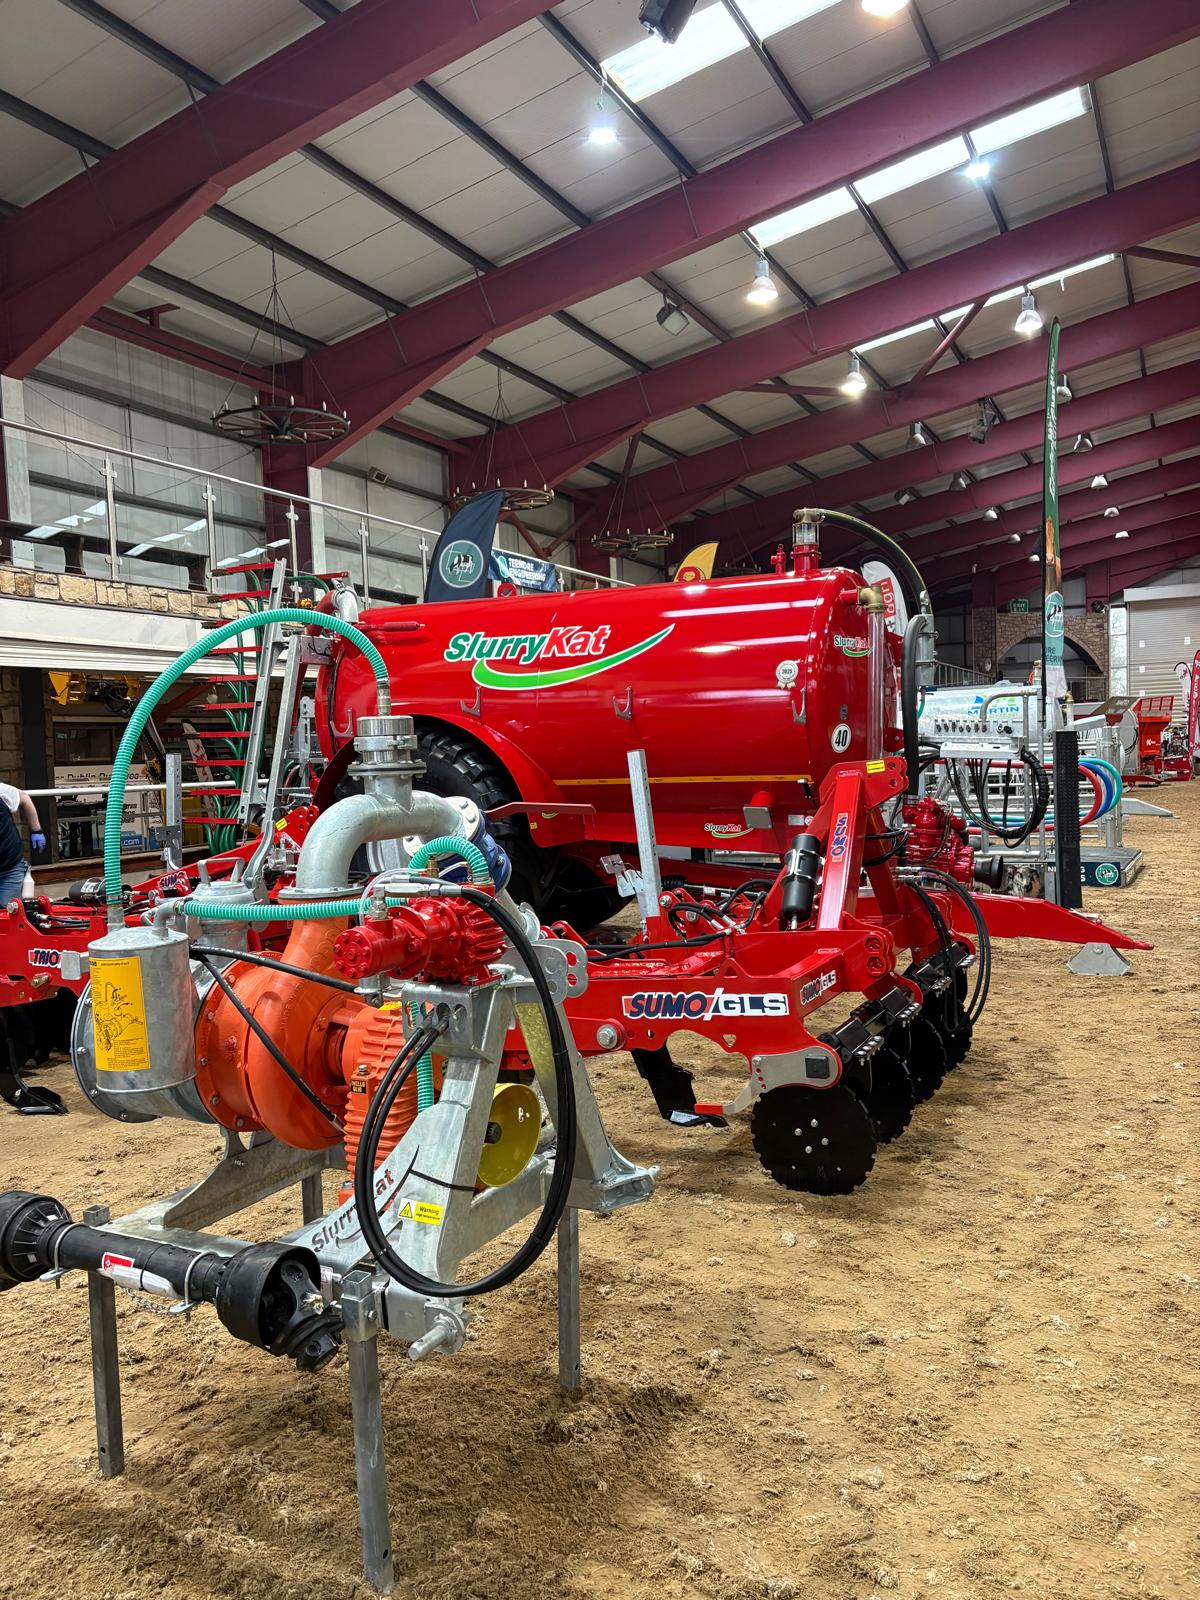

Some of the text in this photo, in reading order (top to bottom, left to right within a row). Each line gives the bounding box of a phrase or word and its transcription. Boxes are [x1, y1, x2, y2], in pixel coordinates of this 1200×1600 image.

[444, 625, 611, 664] SlurryKat
[968, 706, 1020, 716] MRTIN
[835, 729, 848, 747] 40
[704, 823, 742, 833] SlurryKat
[831, 816, 848, 856] SUMO
[311, 1168, 394, 1252] Slurrat
[420, 1206, 439, 1215] Warning
